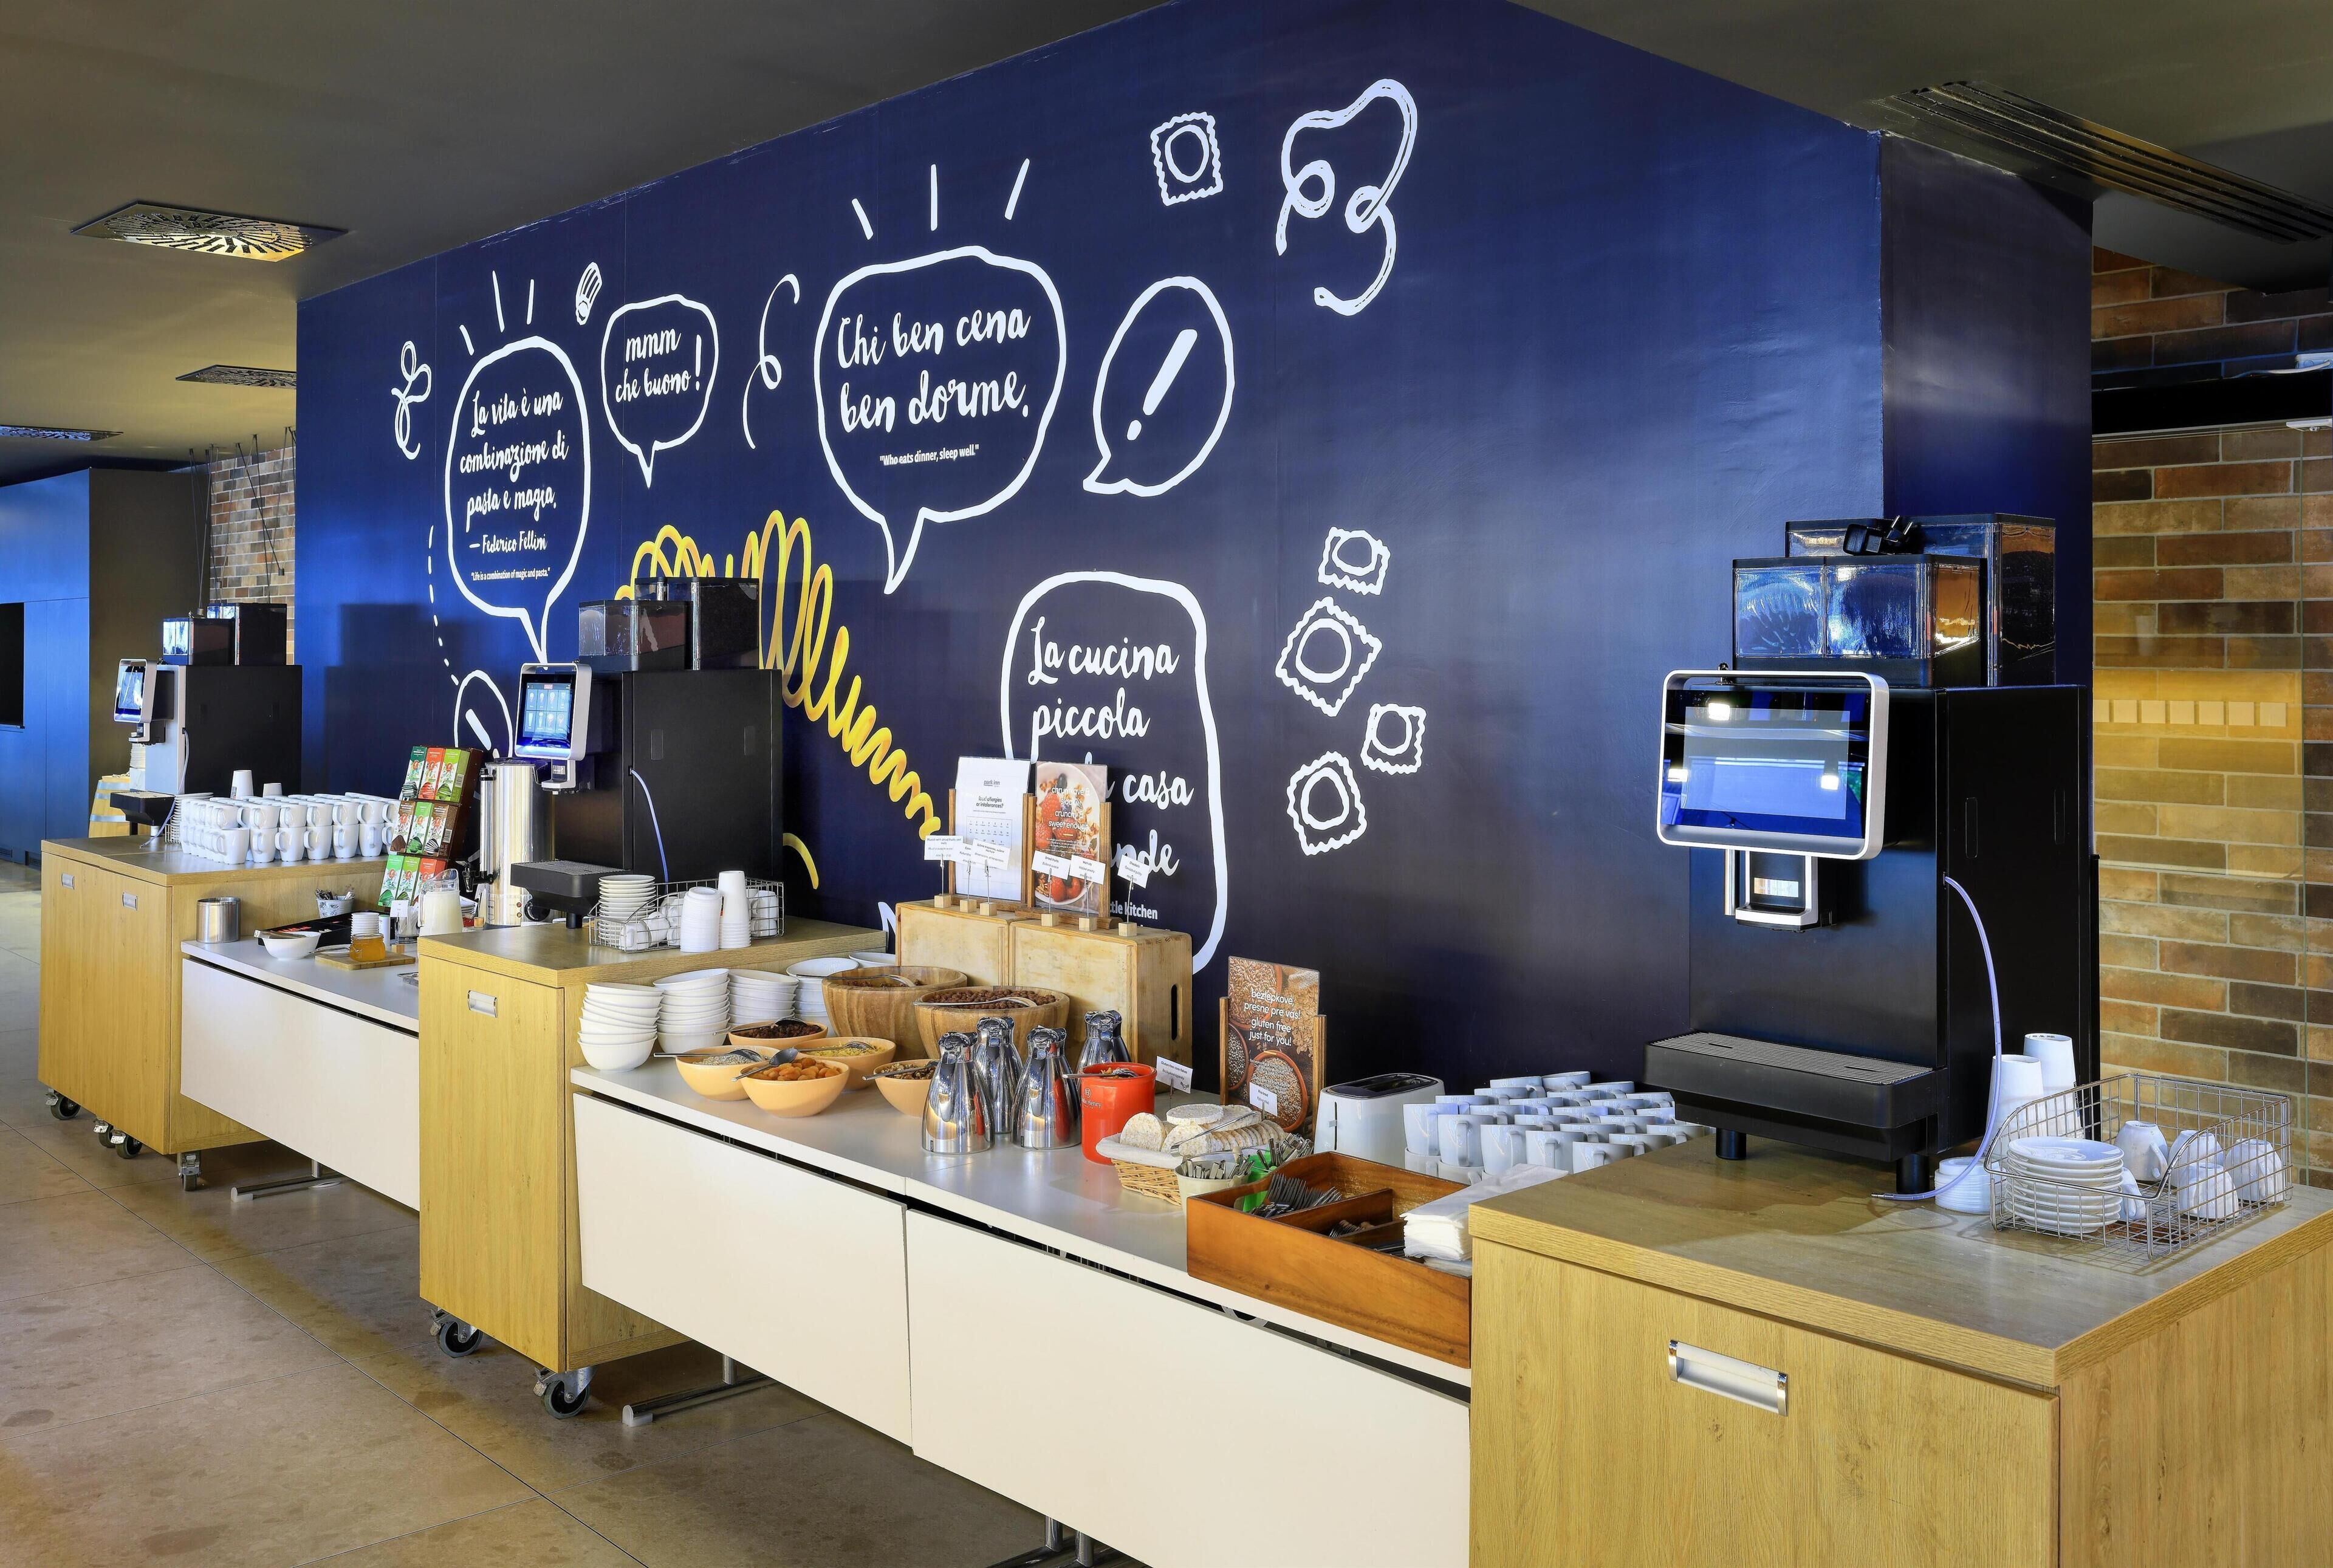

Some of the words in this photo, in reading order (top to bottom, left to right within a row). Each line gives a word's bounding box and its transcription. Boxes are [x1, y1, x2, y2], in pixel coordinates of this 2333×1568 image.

[626, 329, 682, 363] mmm
[838, 313, 886, 368] Chi
[893, 312, 944, 357] ben
[956, 309, 1031, 346] cena
[615, 368, 641, 403] che
[471, 390, 488, 437] La
[492, 392, 518, 425] vita
[521, 388, 530, 417] è
[533, 391, 563, 416] una
[840, 382, 896, 433] ben
[908, 369, 1029, 425] dorme.
[460, 442, 549, 482] combinazione
[552, 430, 569, 460] di
[899, 453, 913, 464] eats
[914, 450, 938, 462] dinner,
[939, 447, 958, 461] sleep
[465, 488, 501, 533] pasta
[503, 490, 511, 509] e
[514, 487, 557, 521] magia.
[482, 534, 517, 554] Federico
[518, 530, 547, 551] Fellini
[480, 571, 484, 580] is
[487, 570, 510, 580] combination
[510, 569, 516, 578] of
[515, 568, 527, 581] magic
[1028, 616, 1065, 685] La
[1068, 637, 1180, 680] cucina
[1031, 687, 1151, 764] piccola
[1124, 770, 1194, 809] casa
[1055, 810, 1078, 820] crunchy
[1066, 822, 1089, 832] enough
[1125, 902, 1158, 920] kitchen
[1244, 1002, 1269, 1013] presne
[1271, 1007, 1284, 1017] pre
[1286, 1008, 1300, 1019] vás!
[1250, 988, 1294, 1007] bezlepkové,
[1249, 1028, 1262, 1041] just
[1264, 1032, 1275, 1042] for
[1276, 1035, 1292, 1046] you!
[1251, 1017, 1275, 1030] gluten
[1276, 1021, 1291, 1033] free
